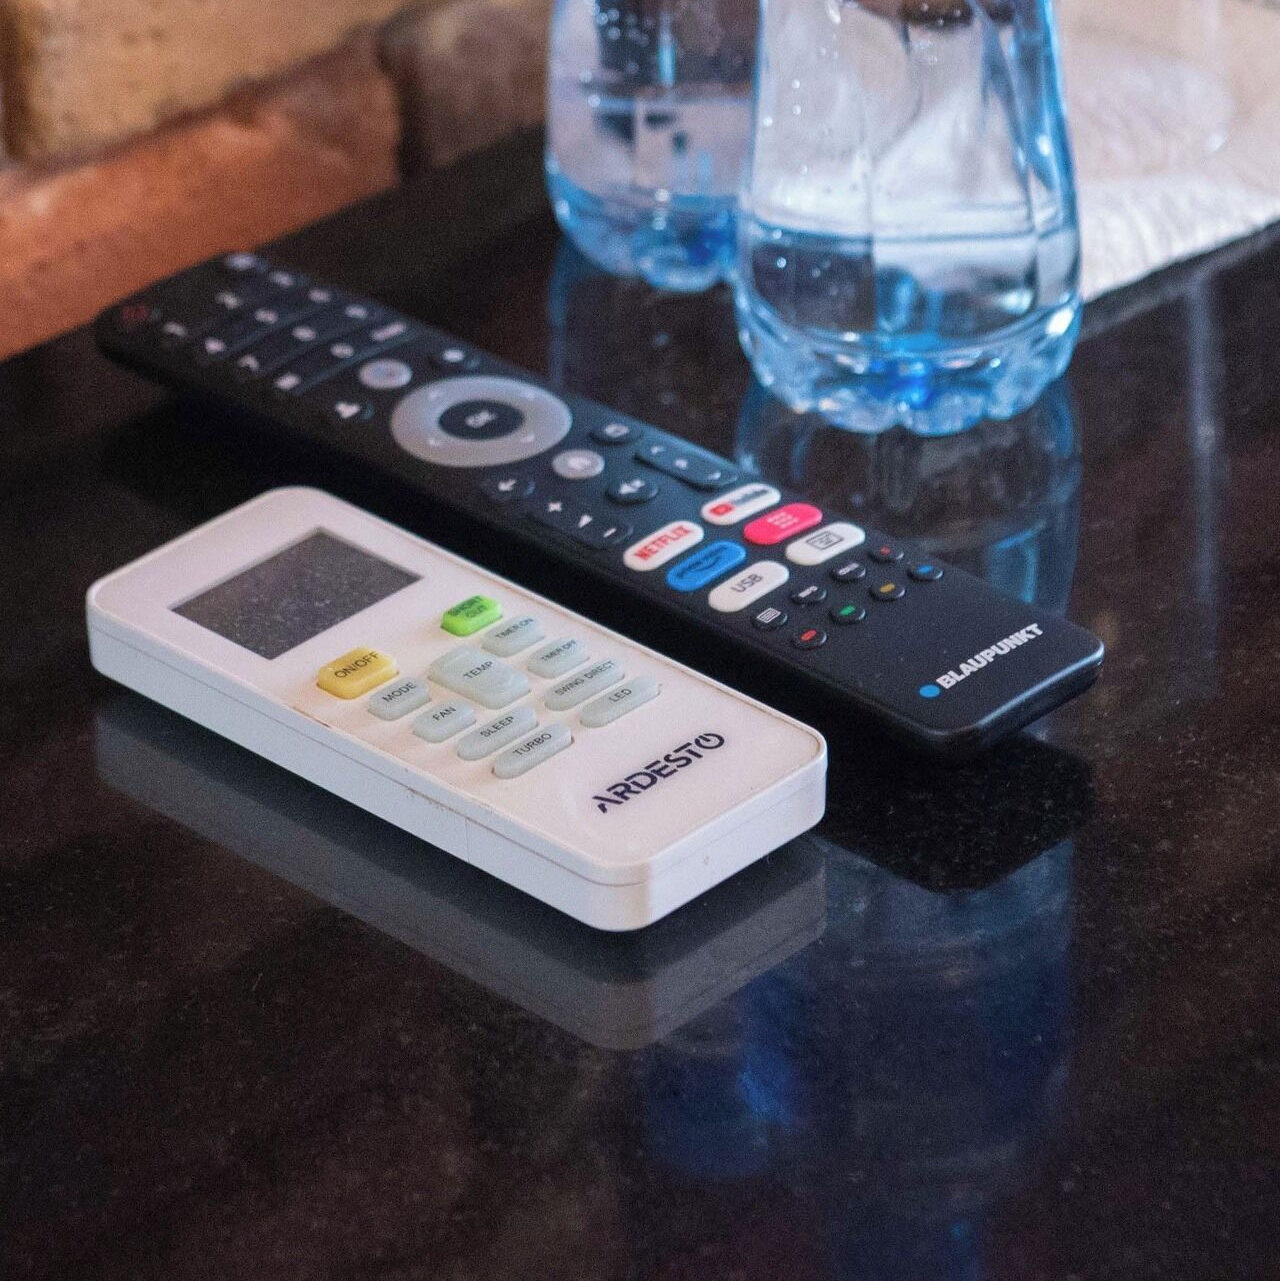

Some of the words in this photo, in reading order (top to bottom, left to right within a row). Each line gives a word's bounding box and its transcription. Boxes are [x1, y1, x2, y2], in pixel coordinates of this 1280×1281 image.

[634, 525, 692, 561] NETFLIX
[731, 574, 763, 593] USB
[495, 624, 519, 639] TIMER
[518, 617, 535, 627] ON
[334, 651, 379, 679] ON/OFF
[541, 648, 564, 661] TIMER
[936, 623, 1043, 689] BLAUPUNKT
[463, 660, 493, 679] TEMP
[555, 678, 584, 696] SWING
[584, 660, 615, 679] DIRECT
[382, 681, 417, 703] MODE
[608, 687, 632, 703] LED
[431, 705, 457, 722] FAN
[480, 715, 514, 738] SLEEP
[513, 733, 552, 756] TURBO
[592, 732, 725, 814] ARDESTO
